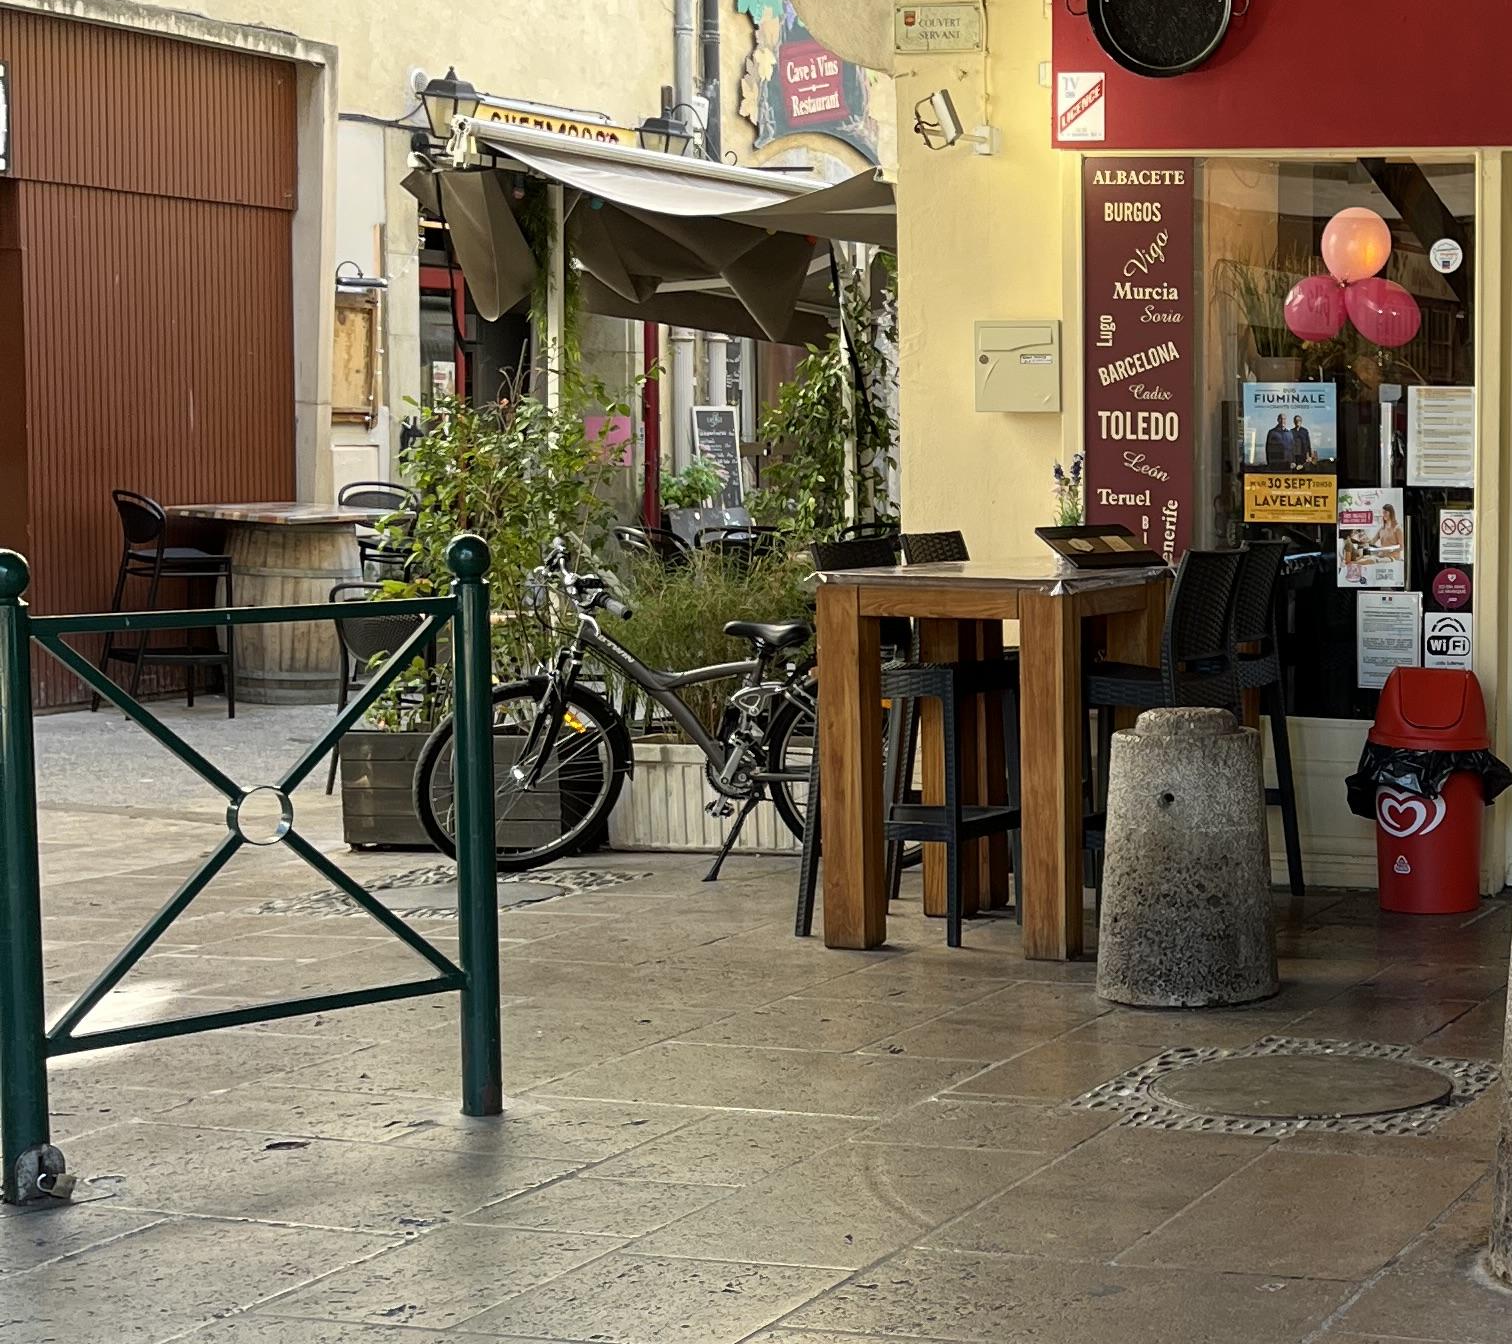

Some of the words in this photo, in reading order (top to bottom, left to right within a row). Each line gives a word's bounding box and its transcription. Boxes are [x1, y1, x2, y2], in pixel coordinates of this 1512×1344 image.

[918, 17, 960, 28] COUVERT
[918, 30, 960, 40] SERVANT
[786, 61, 809, 83] Cave
[816, 55, 838, 77] Vins
[791, 90, 840, 117] Restaurant
[1061, 85, 1103, 129] LICENCE
[1093, 170, 1185, 185] ALBACETE
[1104, 202, 1162, 222] BURGOS
[1123, 228, 1169, 277] Vigo
[1112, 282, 1179, 300] Murcia
[1140, 304, 1184, 323] Soria
[1096, 314, 1116, 347] Lugo
[1098, 341, 1180, 387] BARCELONA
[1128, 383, 1173, 401] Cadix
[1254, 394, 1326, 404] FIUMINALE
[1097, 410, 1179, 442] TOLEDO
[1123, 450, 1170, 482] León
[1267, 477, 1282, 489] 30
[1284, 477, 1313, 489] SEPT
[1097, 488, 1151, 506] Teruel
[1254, 495, 1329, 507] LAVELANET
[1162, 499, 1179, 562] enerife
